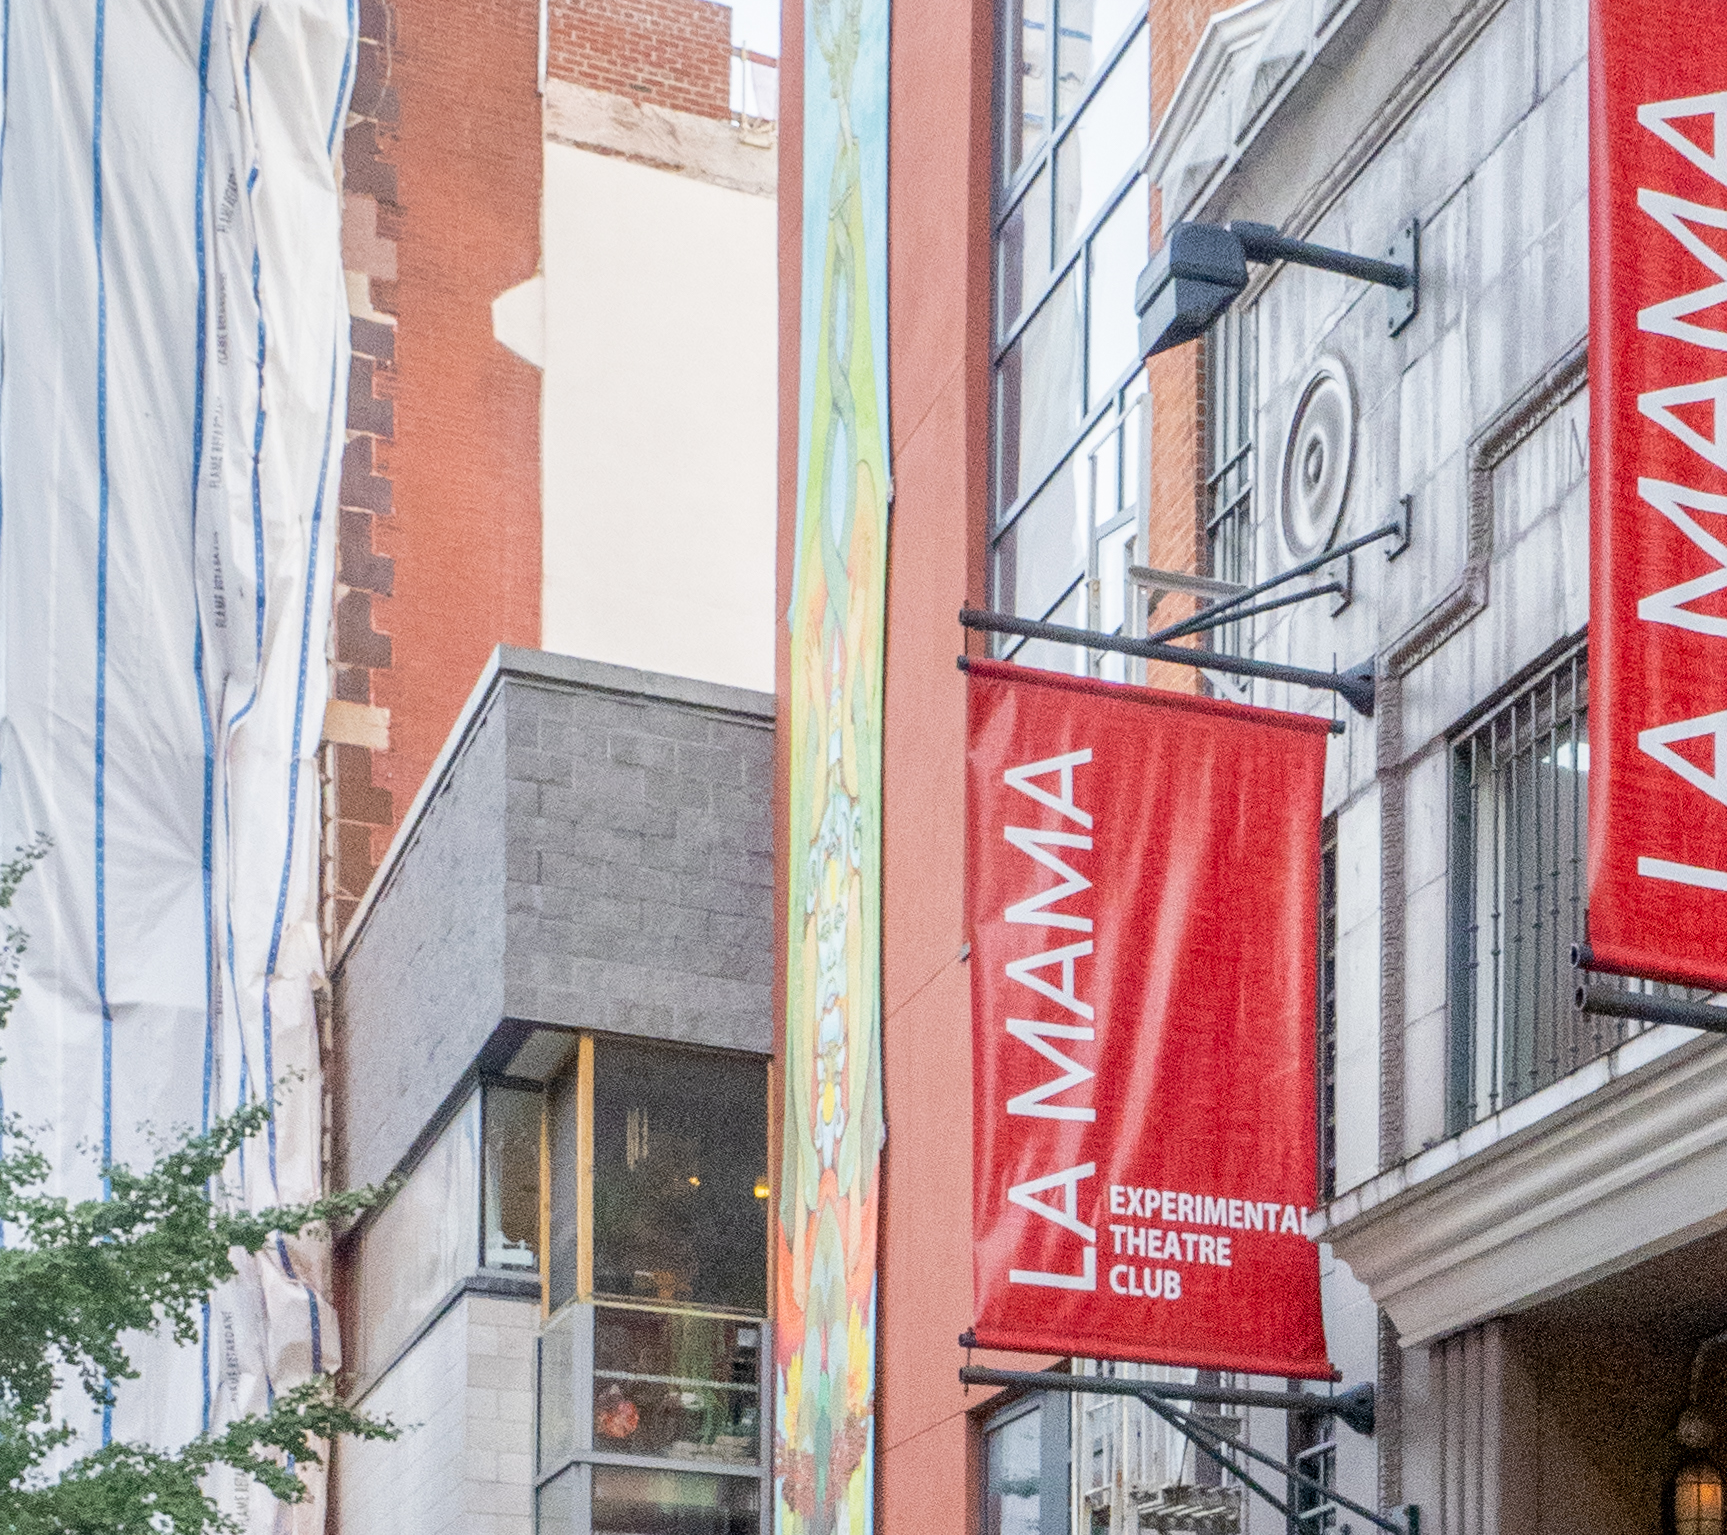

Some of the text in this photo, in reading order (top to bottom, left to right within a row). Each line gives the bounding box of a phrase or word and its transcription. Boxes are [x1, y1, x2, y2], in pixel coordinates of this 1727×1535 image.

[1003, 747, 1097, 1291] LA MAMA
[1108, 1184, 1310, 1236] EXPERIMENTAL
[1108, 1224, 1232, 1267] THEATRE
[1109, 1265, 1182, 1300] CLUB
